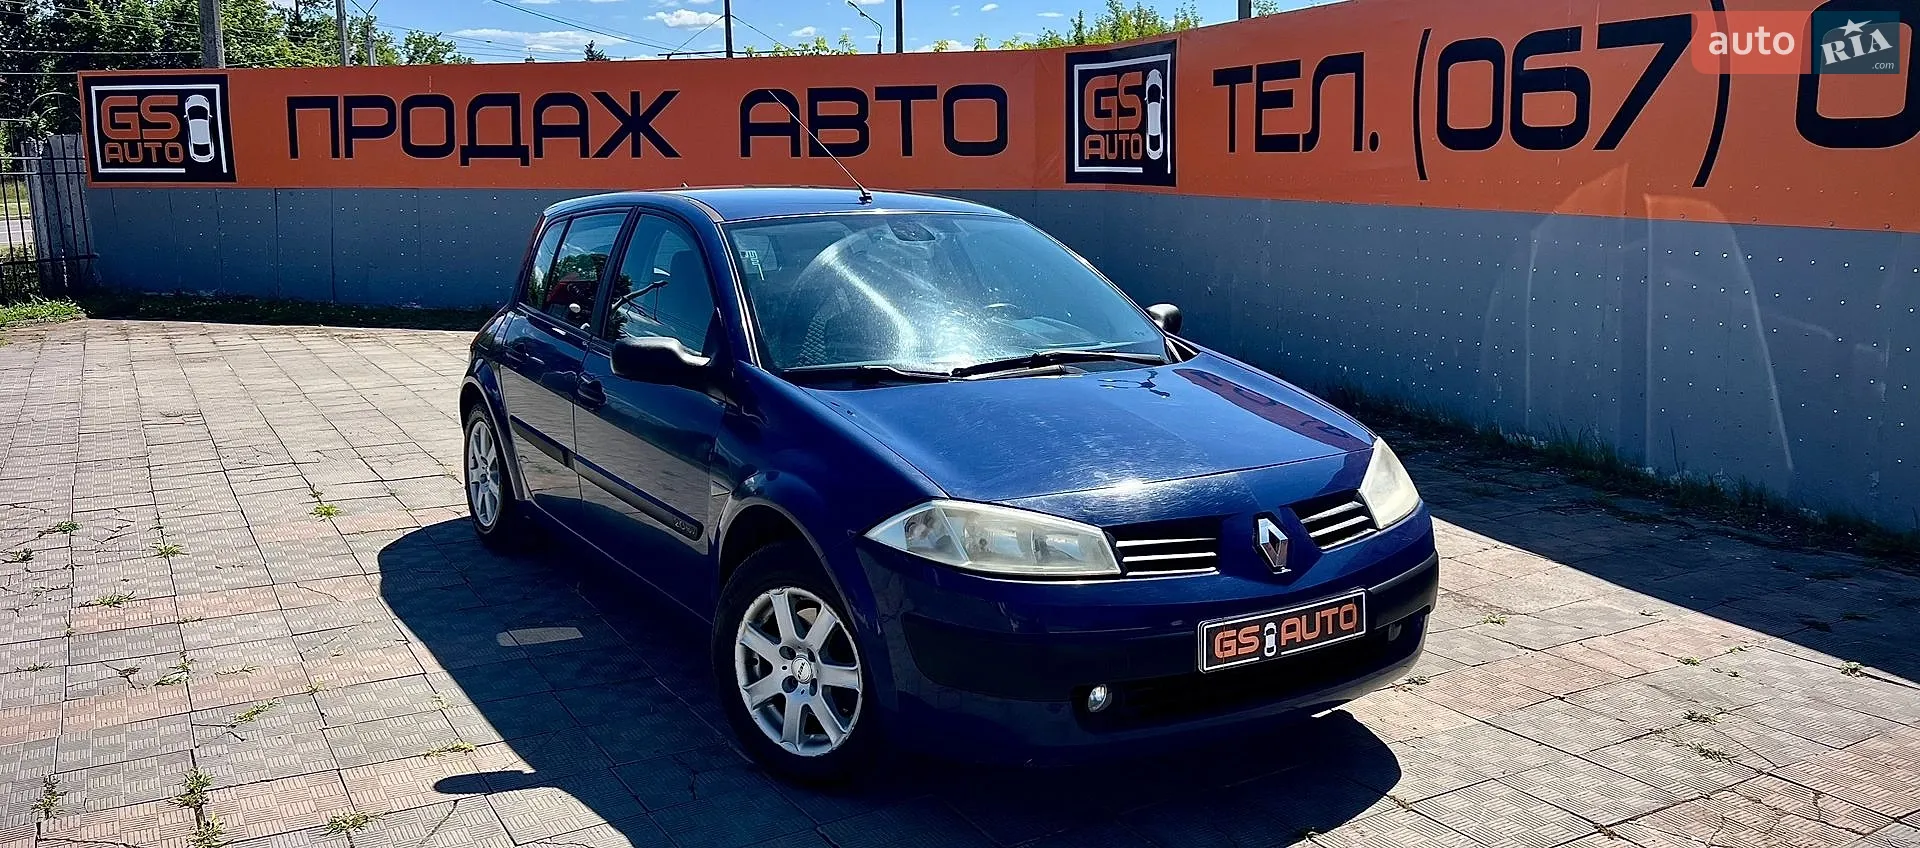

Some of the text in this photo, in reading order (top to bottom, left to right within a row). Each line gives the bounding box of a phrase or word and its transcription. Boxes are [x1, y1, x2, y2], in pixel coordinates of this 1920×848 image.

[101, 94, 180, 140] GS
[1084, 71, 1142, 131] GS
[1213, 51, 1379, 153] ТЕЛ.
[1413, 0, 1731, 188] (067)
[104, 142, 184, 163] AUTO
[286, 83, 1009, 167] ПРОДАЖ АВТО
[1084, 133, 1142, 160] AUTO
[1214, 603, 1357, 659] GS AUTO
